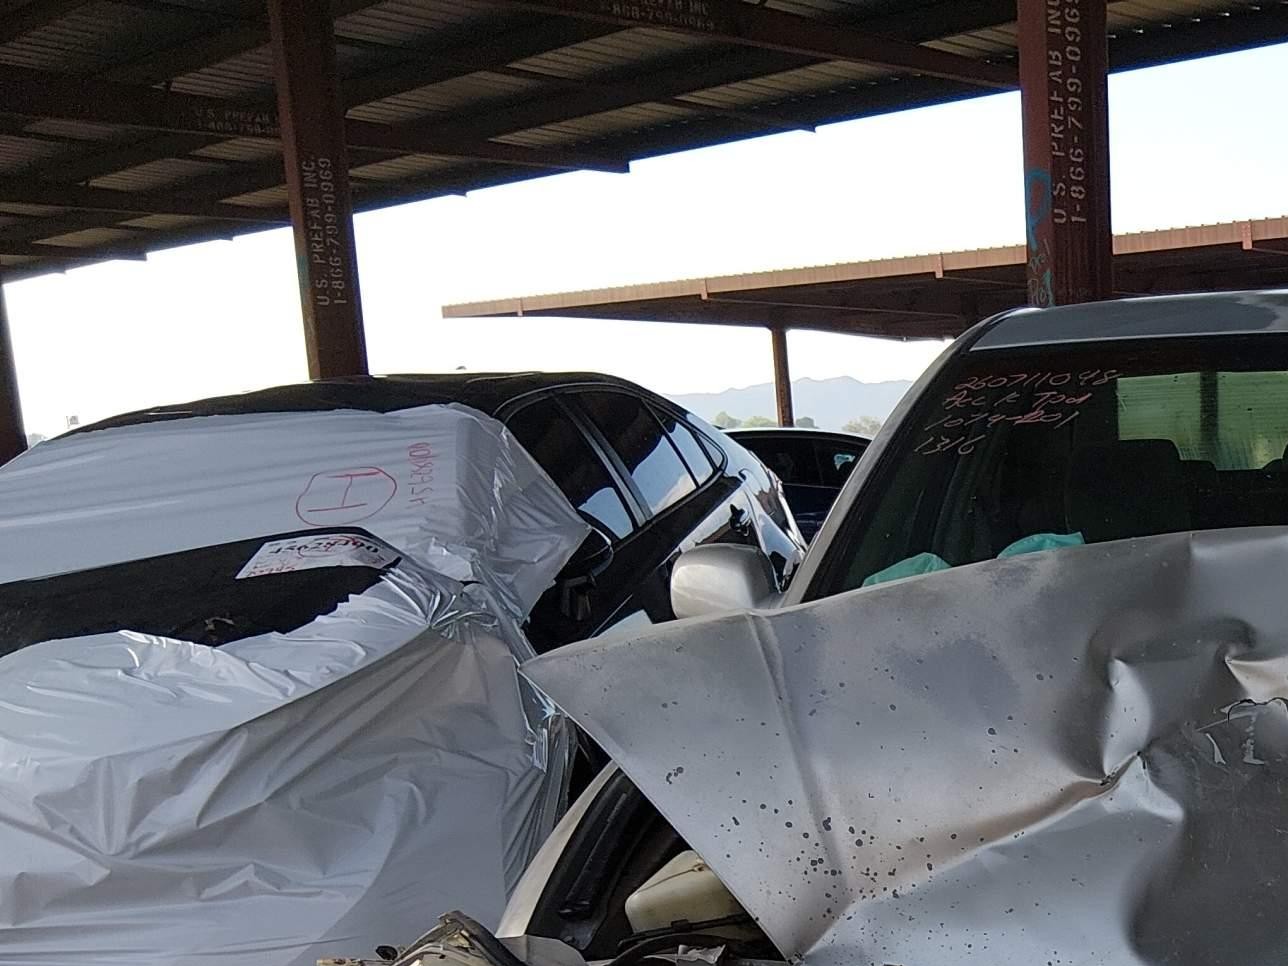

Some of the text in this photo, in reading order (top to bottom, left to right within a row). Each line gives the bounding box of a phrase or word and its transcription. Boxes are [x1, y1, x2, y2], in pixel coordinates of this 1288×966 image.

[1048, 50, 1065, 156] PREFAB
[1064, 0, 1087, 223] 1-866-799-096
[306, 198, 326, 264] PREFAB
[318, 158, 347, 304] 1-866-799-0969
